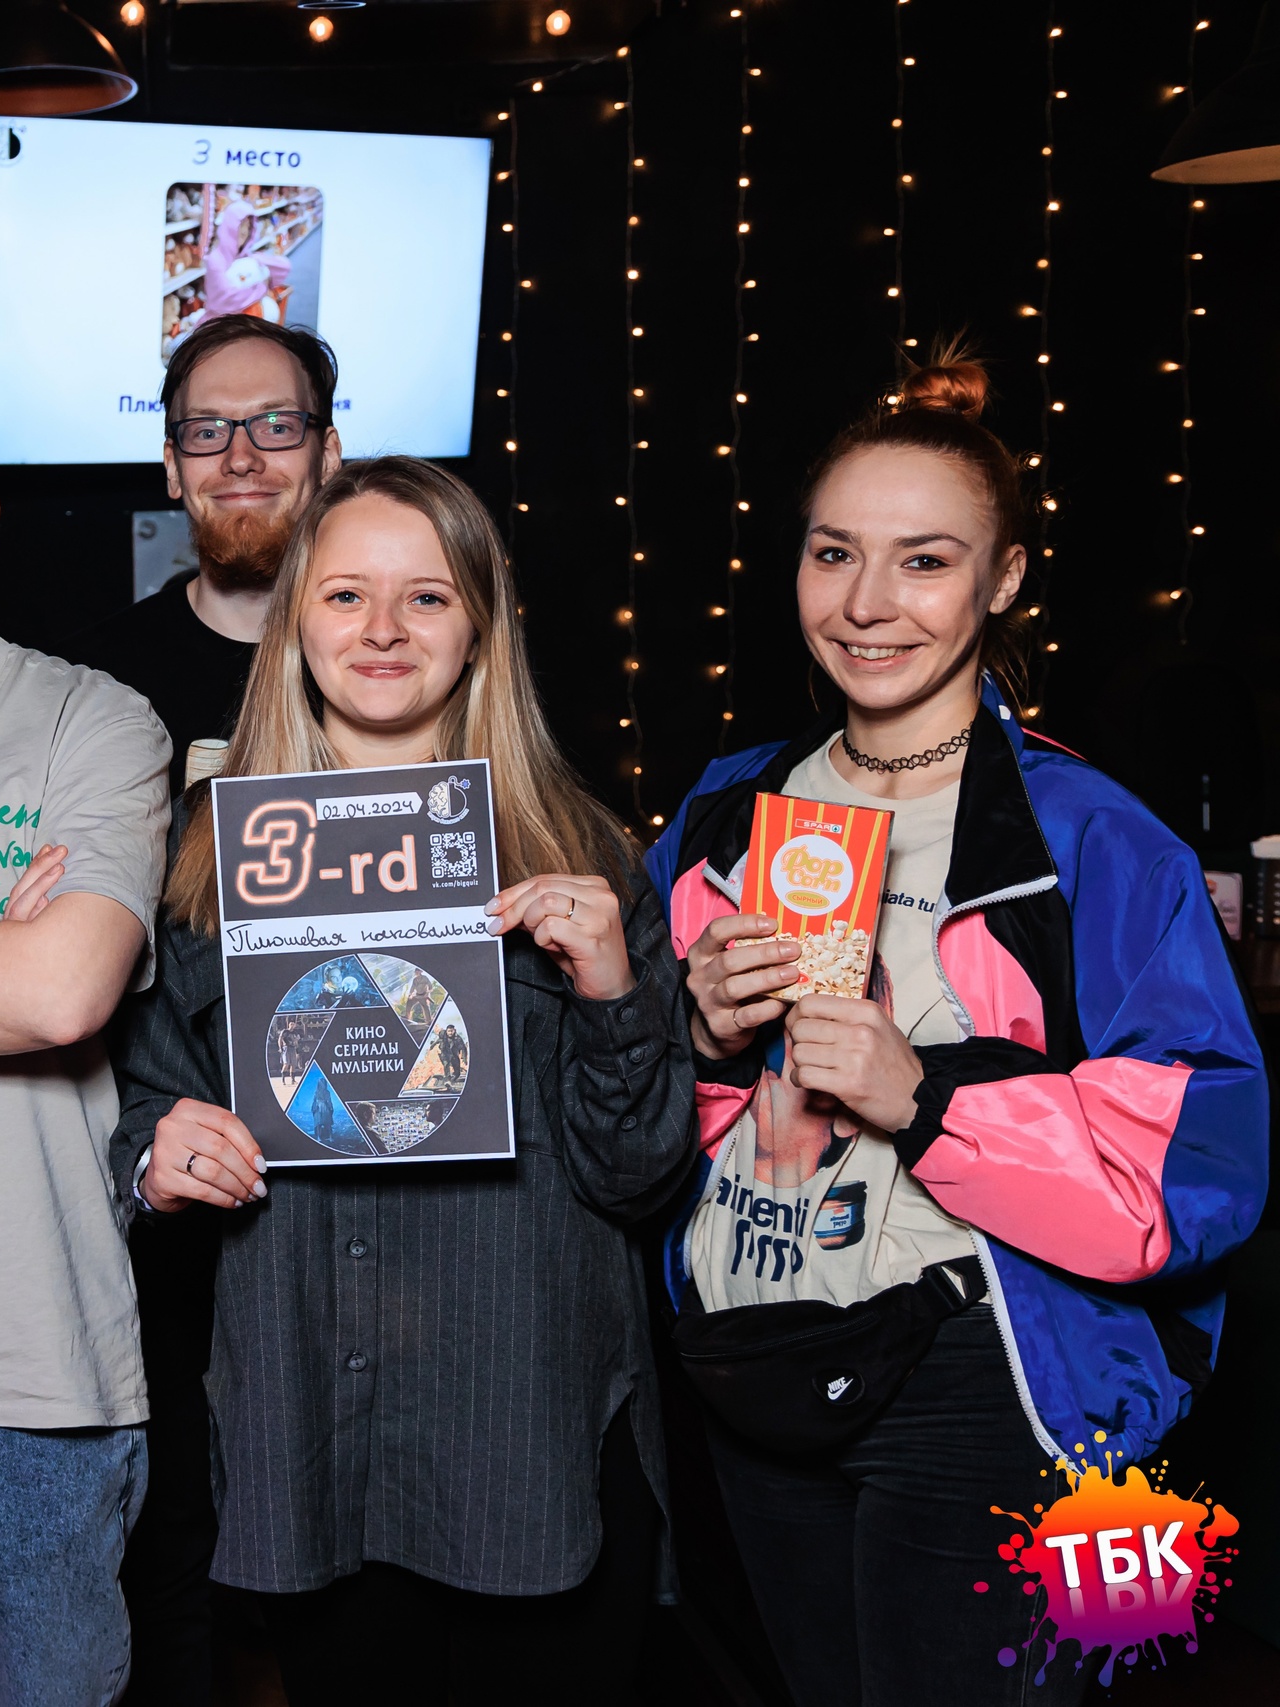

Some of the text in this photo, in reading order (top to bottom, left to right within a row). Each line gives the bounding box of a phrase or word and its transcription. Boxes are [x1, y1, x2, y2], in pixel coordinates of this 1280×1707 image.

[192, 139, 302, 168] 3 место
[322, 800, 415, 820] 02.04.2024
[803, 821, 831, 831] SPAR
[780, 844, 844, 877] Pop
[432, 879, 479, 890] vk.com/bigquiz
[786, 868, 841, 893] Corn
[792, 894, 823, 905] СЫРНЫЙ
[226, 920, 489, 953] Плюшевая наковальня
[346, 1025, 386, 1040] КИНО
[334, 1042, 399, 1057] СЕРИАЛЫ
[331, 1059, 404, 1074] МУЛЬТИКИ
[827, 1376, 846, 1393] NIKE
